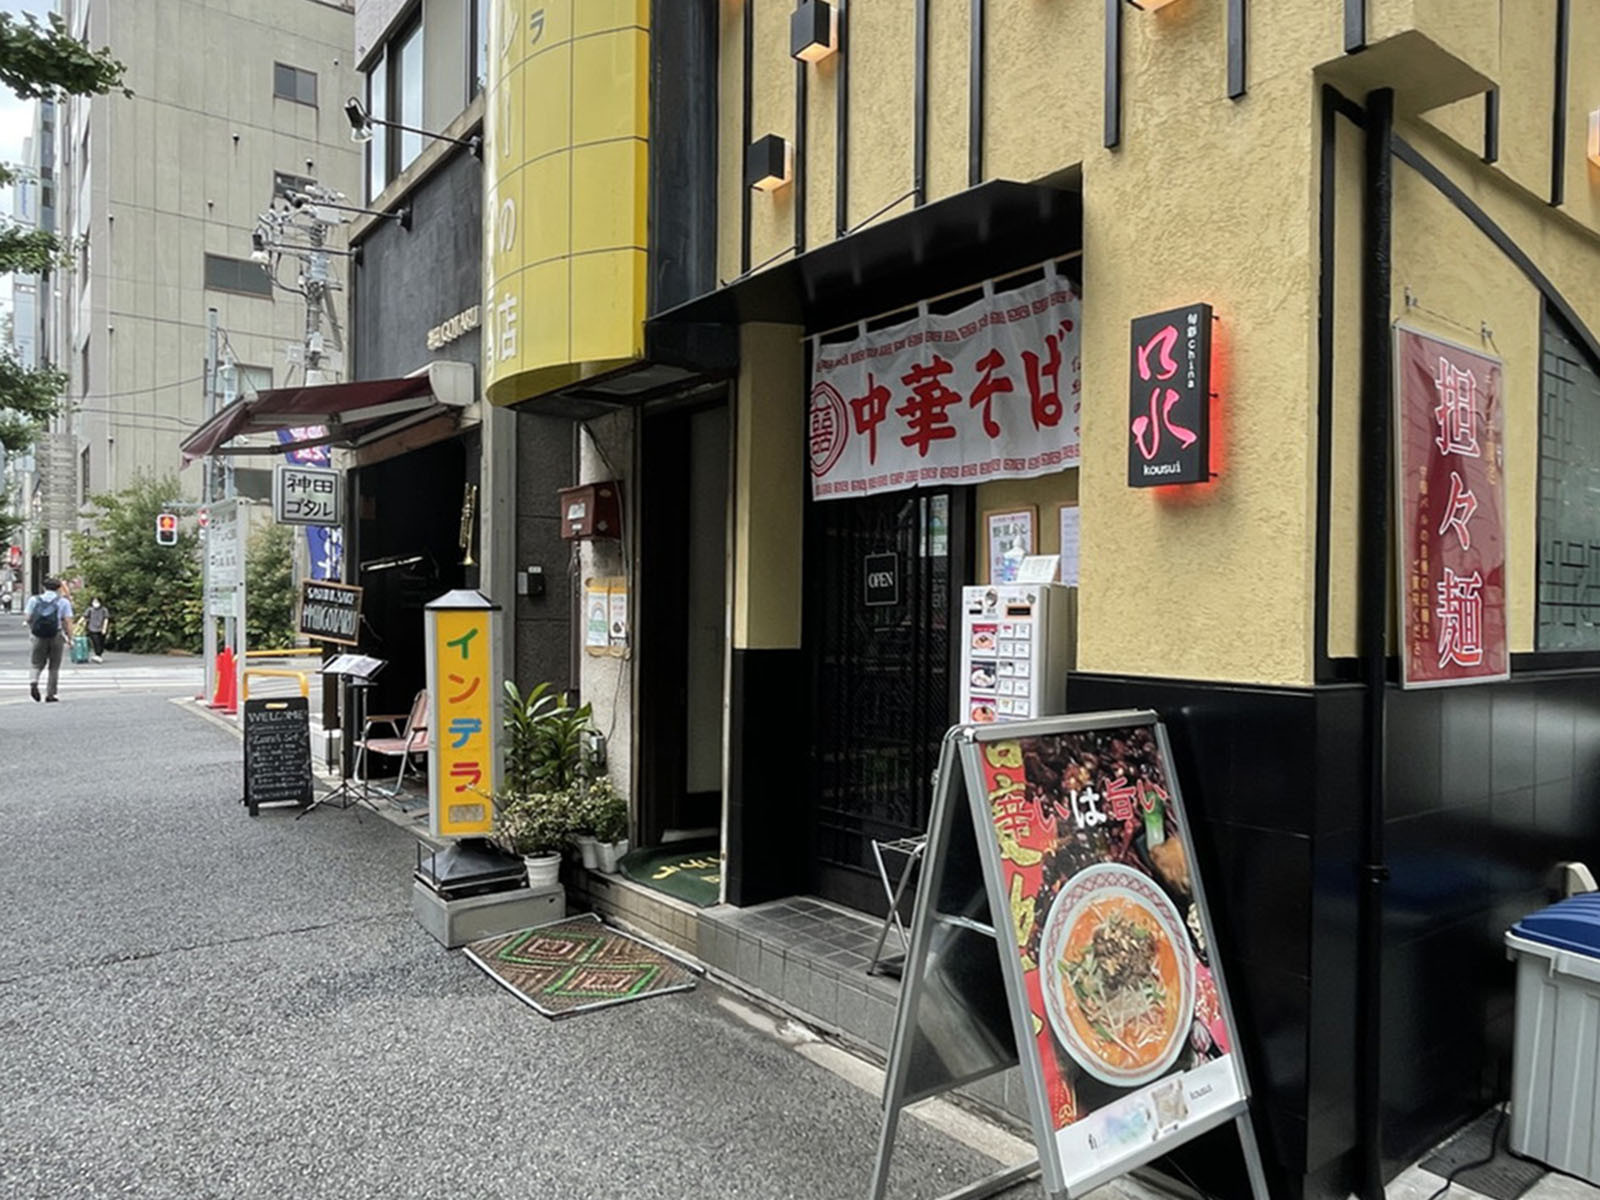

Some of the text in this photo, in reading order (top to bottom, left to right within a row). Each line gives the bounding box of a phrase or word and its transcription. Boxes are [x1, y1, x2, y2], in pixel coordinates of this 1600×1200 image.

[848, 318, 1074, 466] 中華そば
[1143, 460, 1182, 476] kousui
[286, 474, 334, 495] 神田
[286, 497, 334, 518] ゴタル
[867, 571, 894, 589] OPEN
[248, 711, 305, 723] WELCOME
[446, 627, 483, 793] インデラ
[991, 775, 1171, 841] 辛いは旨い
